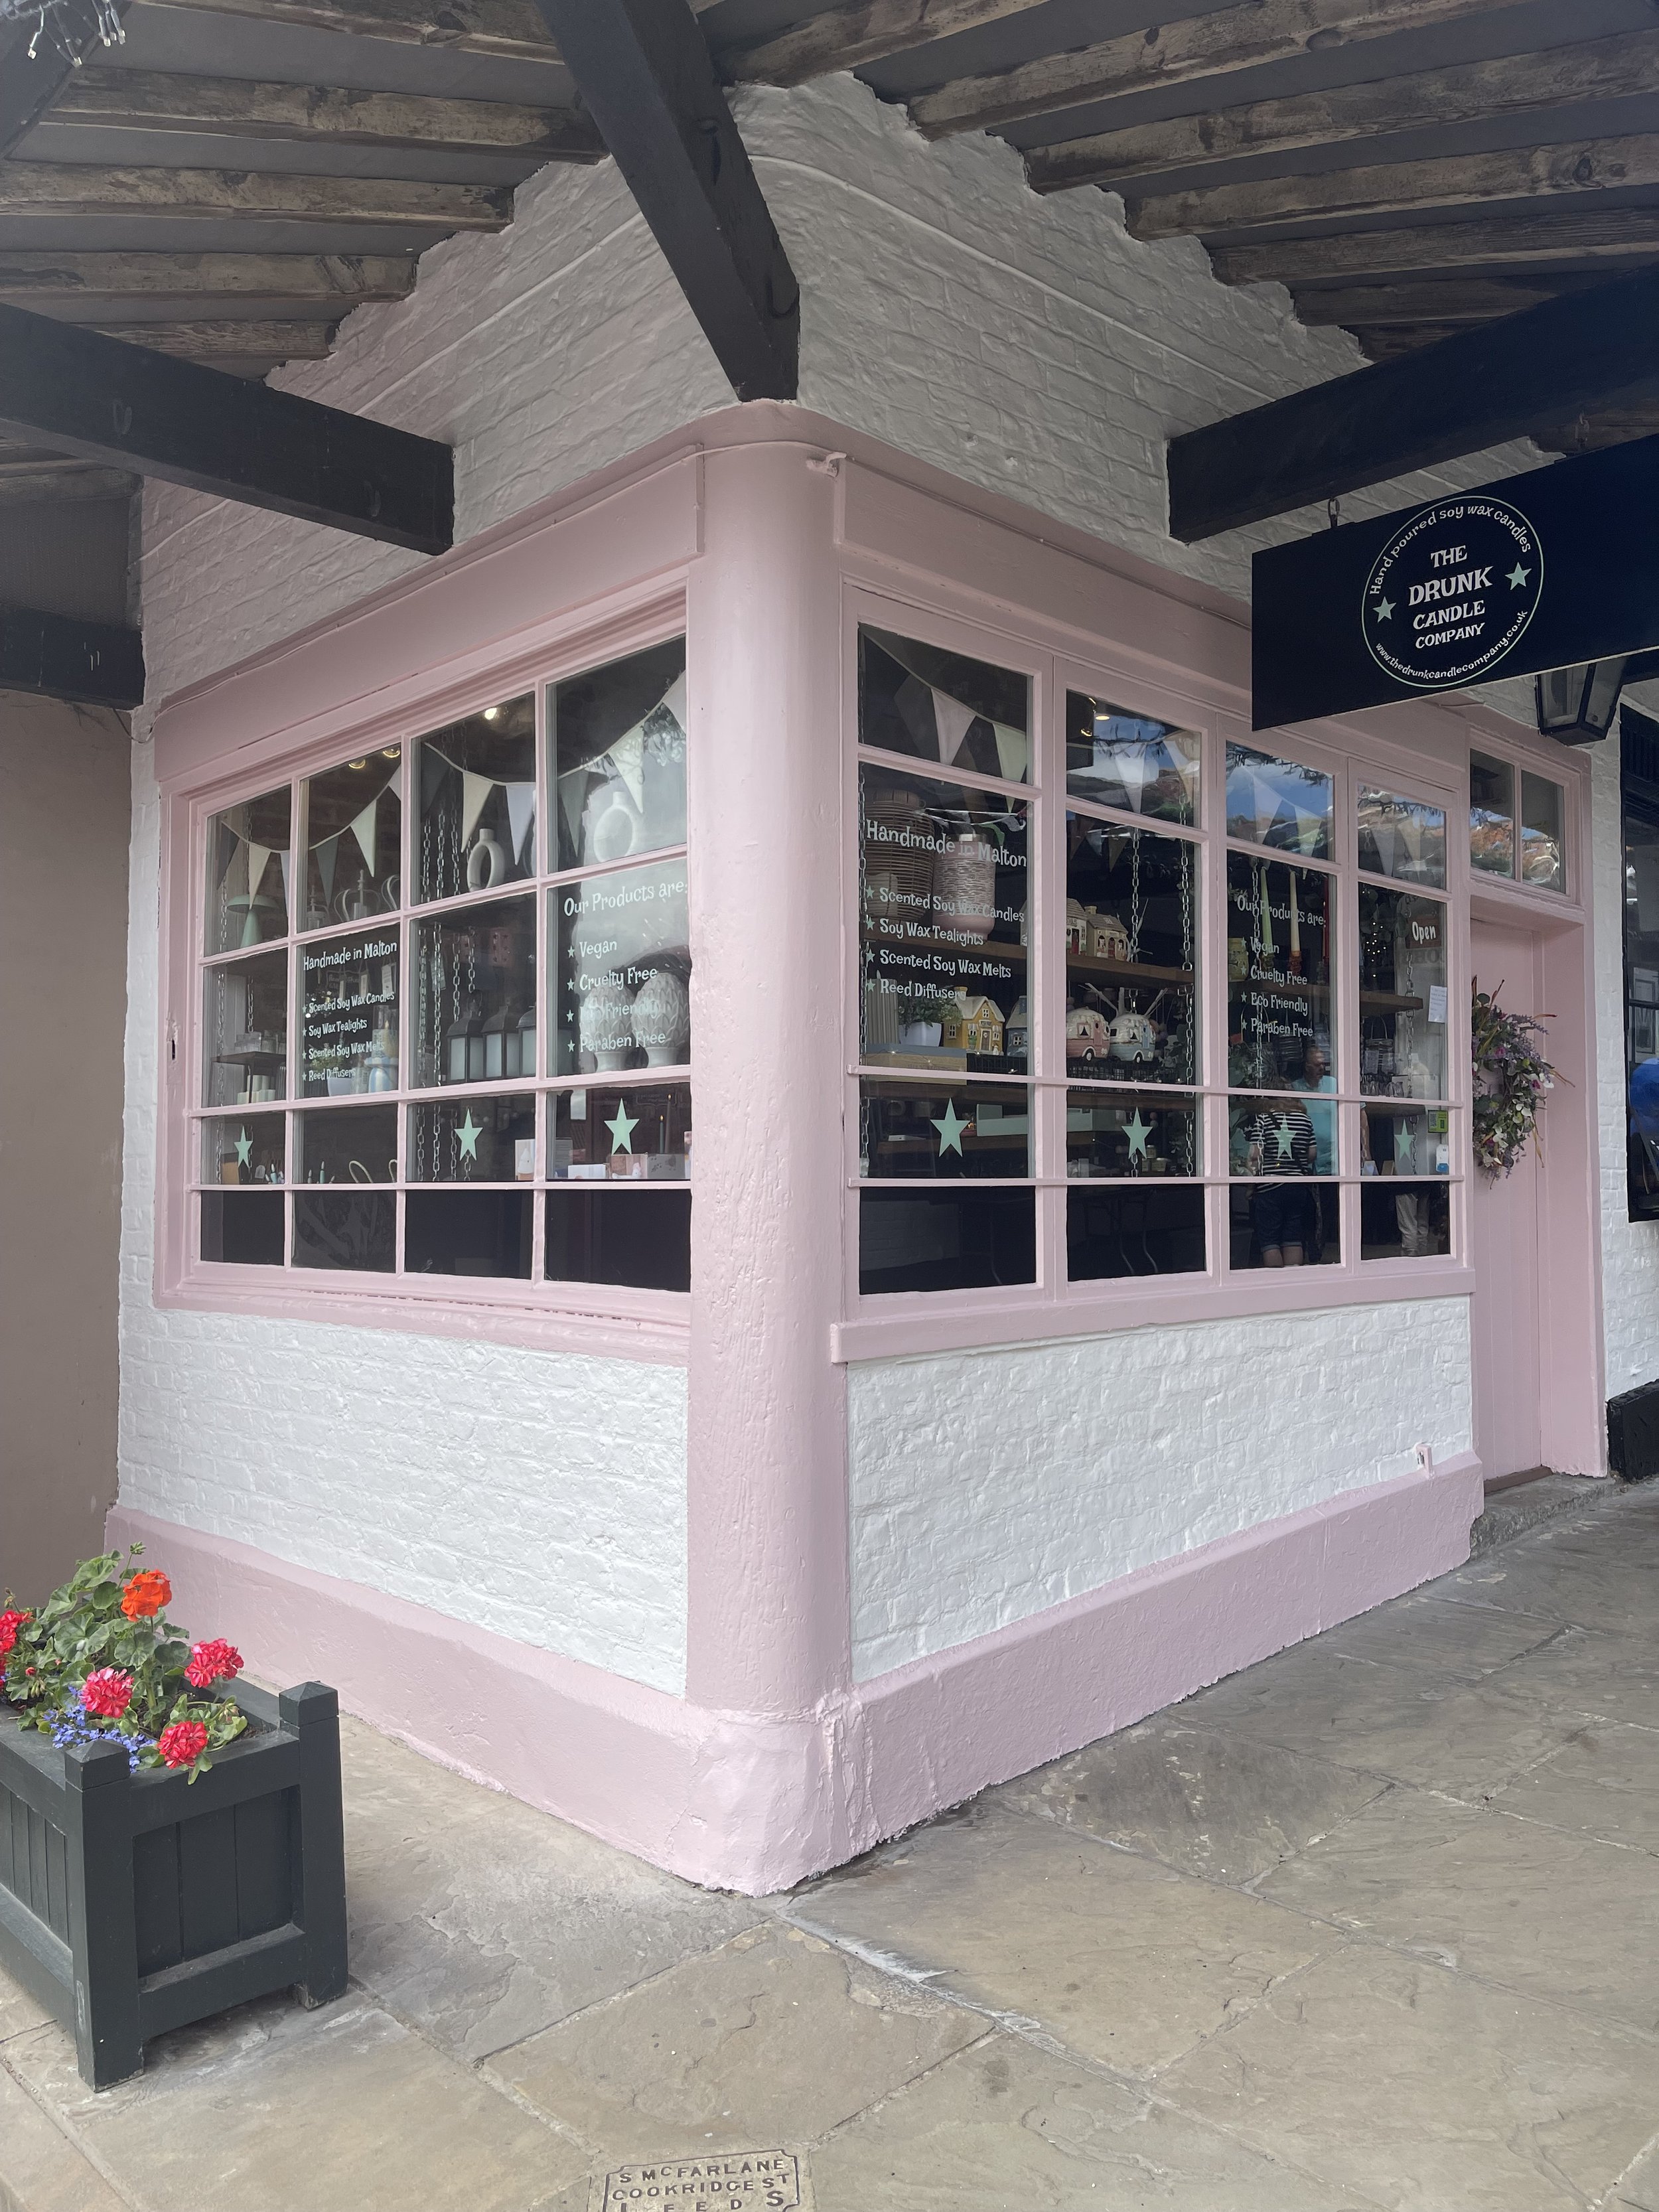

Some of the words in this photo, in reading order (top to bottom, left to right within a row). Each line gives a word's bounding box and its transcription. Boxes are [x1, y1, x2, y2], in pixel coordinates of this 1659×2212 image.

[1370, 556, 1394, 595] Hand
[1390, 511, 1437, 558] poured
[1439, 506, 1464, 520] soy
[1467, 505, 1494, 517] wax
[1494, 510, 1531, 553] candles
[1431, 545, 1467, 568] THE
[1408, 565, 1494, 606] DRUNK
[1413, 600, 1485, 630] CANDLE
[1375, 609, 1528, 680] www.thedrunkcandlecompany.co.uk
[1415, 623, 1485, 649] COMPANY
[866, 820, 956, 854] Handmade
[958, 843, 973, 856] in
[978, 842, 1027, 867] Malton
[563, 897, 589, 917] Our
[592, 886, 655, 911] Products
[879, 887, 931, 909] Scented
[932, 896, 956, 915] Soy
[956, 899, 982, 915] Wax
[982, 903, 1025, 922] Candles
[1236, 895, 1260, 912] Our
[1260, 899, 1305, 923] Products
[879, 918, 904, 939] Soy
[906, 922, 931, 938] Wax
[932, 925, 983, 947] Tealights
[1411, 921, 1437, 945] Open
[303, 947, 351, 972] Handmade
[353, 948, 362, 960] in
[364, 940, 397, 960] Malton
[579, 940, 617, 960] Vegan
[1250, 936, 1280, 955] Vegan
[879, 949, 931, 970] Scented
[933, 956, 956, 976] Soy
[958, 959, 981, 974] Wax
[983, 962, 1012, 978] Melts
[579, 969, 625, 992] Cruelty
[627, 966, 658, 985] Free
[1250, 965, 1285, 988] Cruelty
[1287, 971, 1308, 986] Free
[880, 978, 912, 997] Reed
[914, 983, 967, 1001] Diffusers
[309, 998, 336, 1014] Scented
[336, 995, 351, 1011] Soy
[351, 995, 366, 1007] Wax
[366, 991, 395, 1003] Candles
[606, 997, 660, 1019] Friendly
[1250, 992, 1269, 1008] Eco
[1270, 995, 1309, 1017] Friendly
[309, 1024, 322, 1039] Soy
[322, 1022, 336, 1034] Wax
[336, 1017, 368, 1033] Tealights
[1250, 1018, 1291, 1035] Paraben
[1292, 1022, 1313, 1037] Free
[309, 1044, 336, 1061] Scented
[336, 1043, 350, 1059] Soy
[350, 1041, 366, 1053] Wax
[366, 1040, 385, 1053] Melts
[580, 1035, 632, 1053] Paraben
[635, 1030, 666, 1048] Free
[309, 1069, 326, 1082] Reed
[326, 1067, 356, 1081] Diffusers
[612, 2180, 755, 2201] COOKRIDGE
[762, 2174, 790, 2189] ST
[619, 2172, 632, 2183] S
